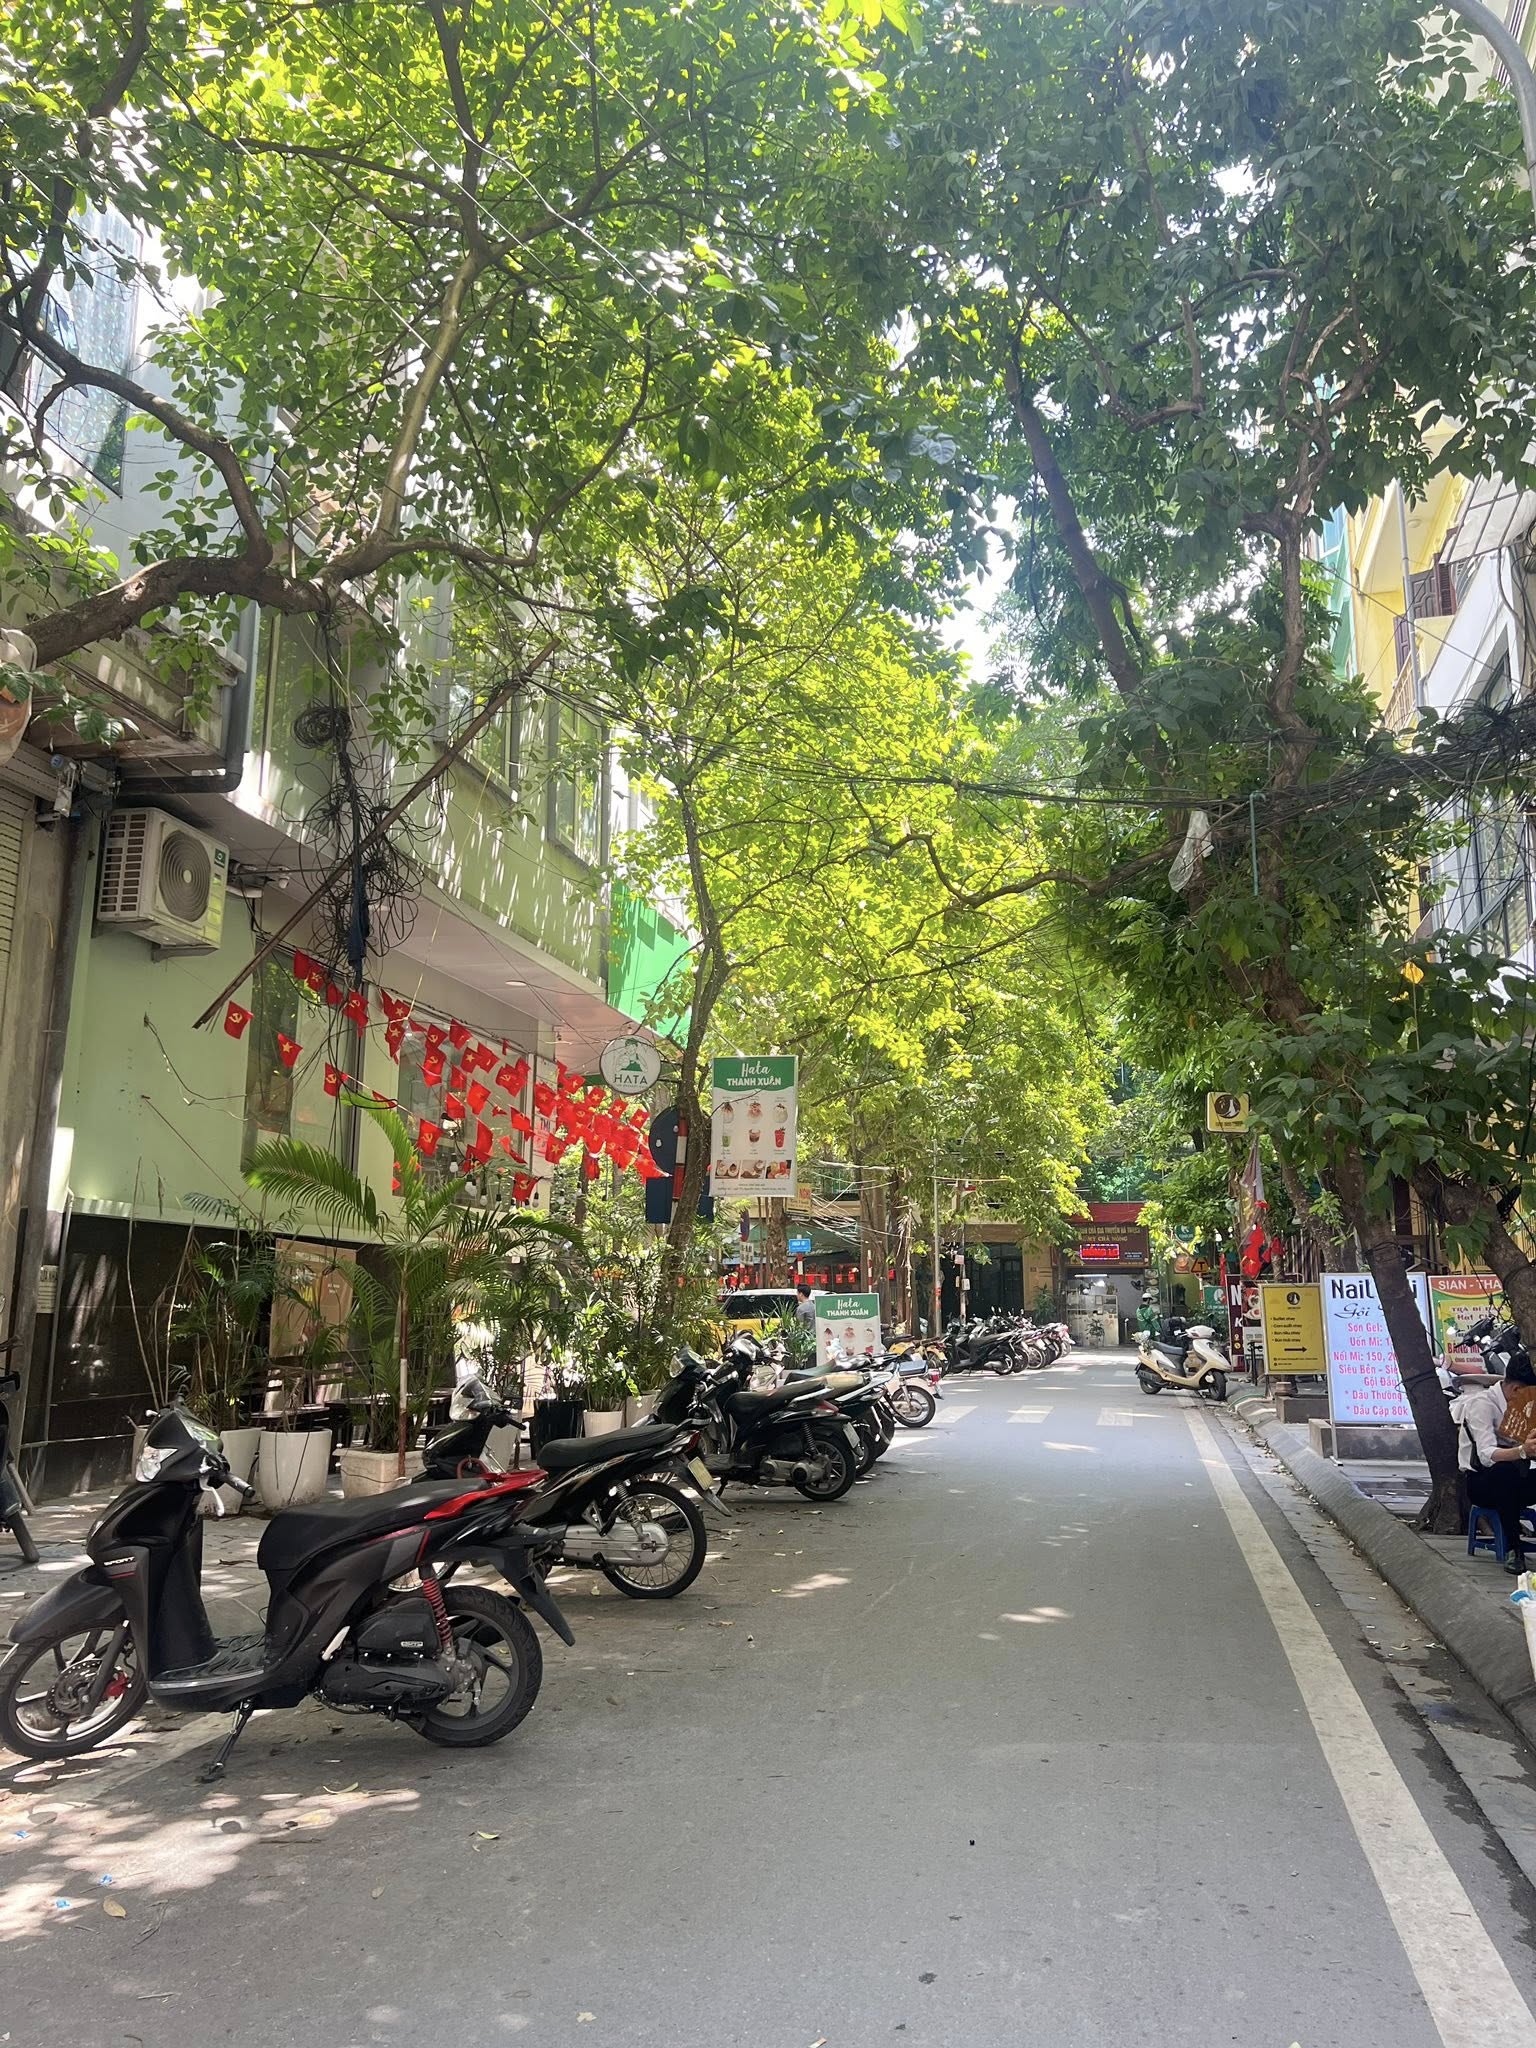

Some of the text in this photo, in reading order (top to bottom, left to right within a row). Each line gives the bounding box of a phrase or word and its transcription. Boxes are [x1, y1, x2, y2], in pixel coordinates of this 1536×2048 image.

[741, 1061, 771, 1077] Hata
[613, 1074, 648, 1085] HATA
[727, 1076, 782, 1086] THANH XUÂN
[1331, 1279, 1375, 1299] Nail
[1438, 1280, 1467, 1290] SIAN
[1475, 1279, 1503, 1290] THA
[837, 1297, 860, 1309] Hata
[850, 1308, 869, 1316] XUÂN
[1366, 1322, 1383, 1333] Gel:
[1366, 1351, 1386, 1362] 150,
